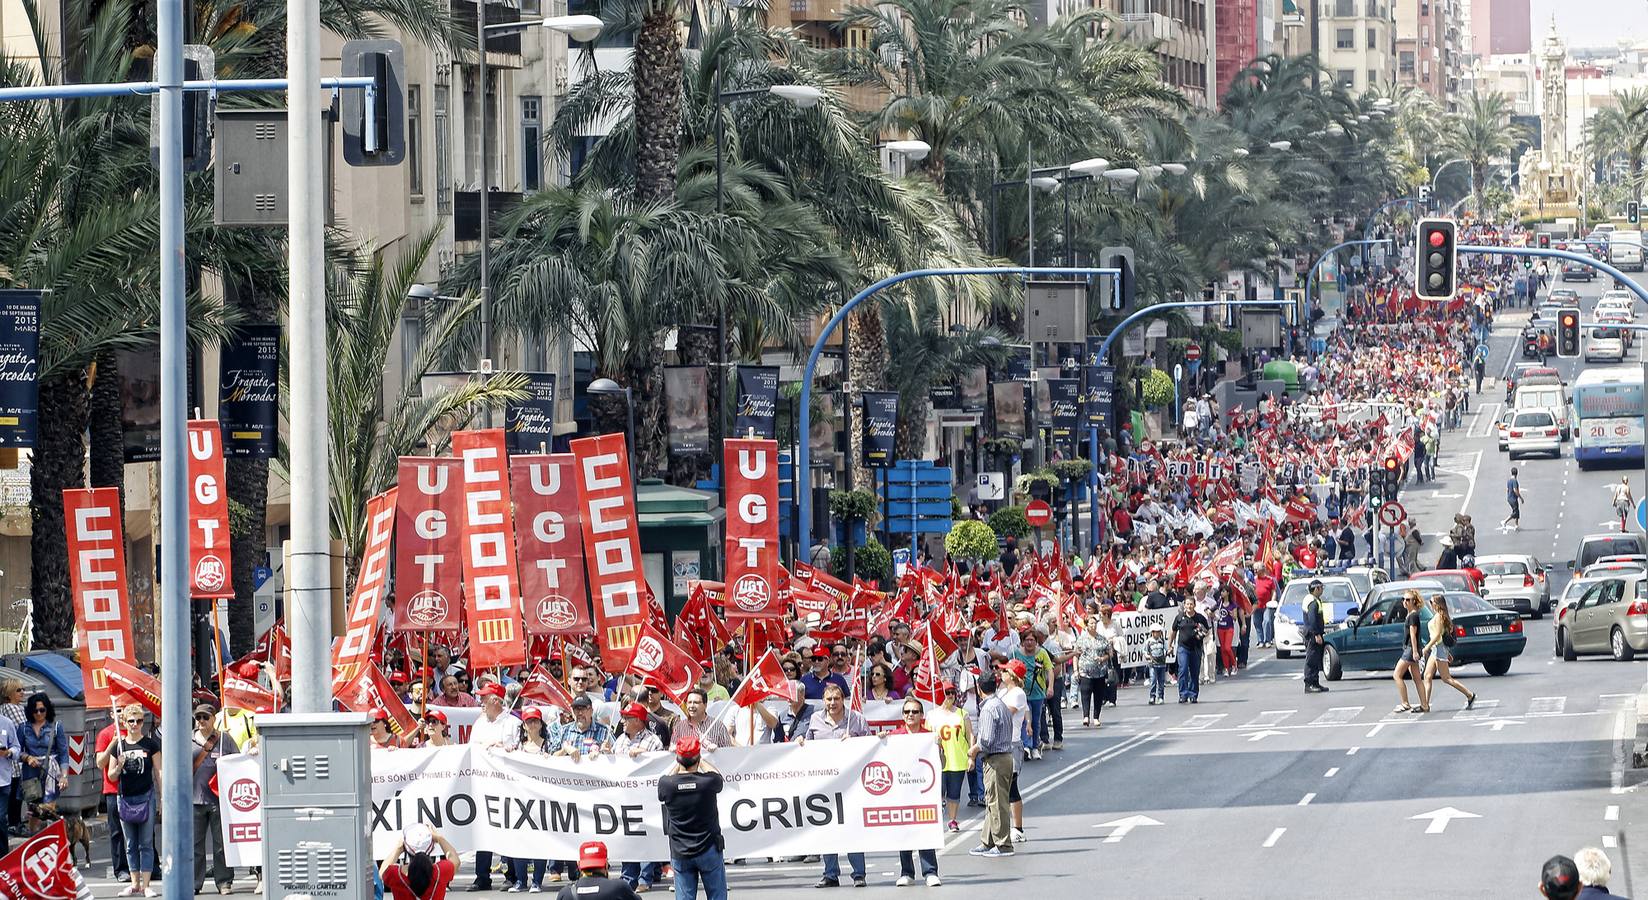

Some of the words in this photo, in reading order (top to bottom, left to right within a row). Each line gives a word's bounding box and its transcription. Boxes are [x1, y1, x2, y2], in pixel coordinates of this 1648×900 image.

[15, 316, 37, 325] 2015
[221, 369, 270, 392] Fragata
[507, 407, 545, 427] Fragata
[188, 430, 220, 549] UGT
[738, 450, 768, 568] UGT
[415, 465, 449, 584] UGT
[462, 447, 512, 611] CCOO
[529, 463, 566, 589] UGT
[582, 453, 641, 618] CCOO
[199, 562, 220, 579] UGT
[74, 506, 126, 661] CCOO
[339, 505, 392, 658] CCOO
[739, 580, 765, 594] UGT
[811, 578, 839, 597] CCOO
[413, 597, 442, 611] UGT
[542, 601, 570, 615] UGT
[796, 599, 826, 610] CCOO
[640, 638, 661, 661] UGT
[407, 773, 419, 782] EL
[574, 778, 585, 787] DE
[865, 766, 890, 780] UGT
[231, 782, 260, 799] UGT
[417, 793, 478, 829] NO
[485, 794, 580, 834] EIXIM
[593, 803, 648, 836] DE
[730, 791, 845, 832] CRISI
[866, 809, 914, 824] CCOO
